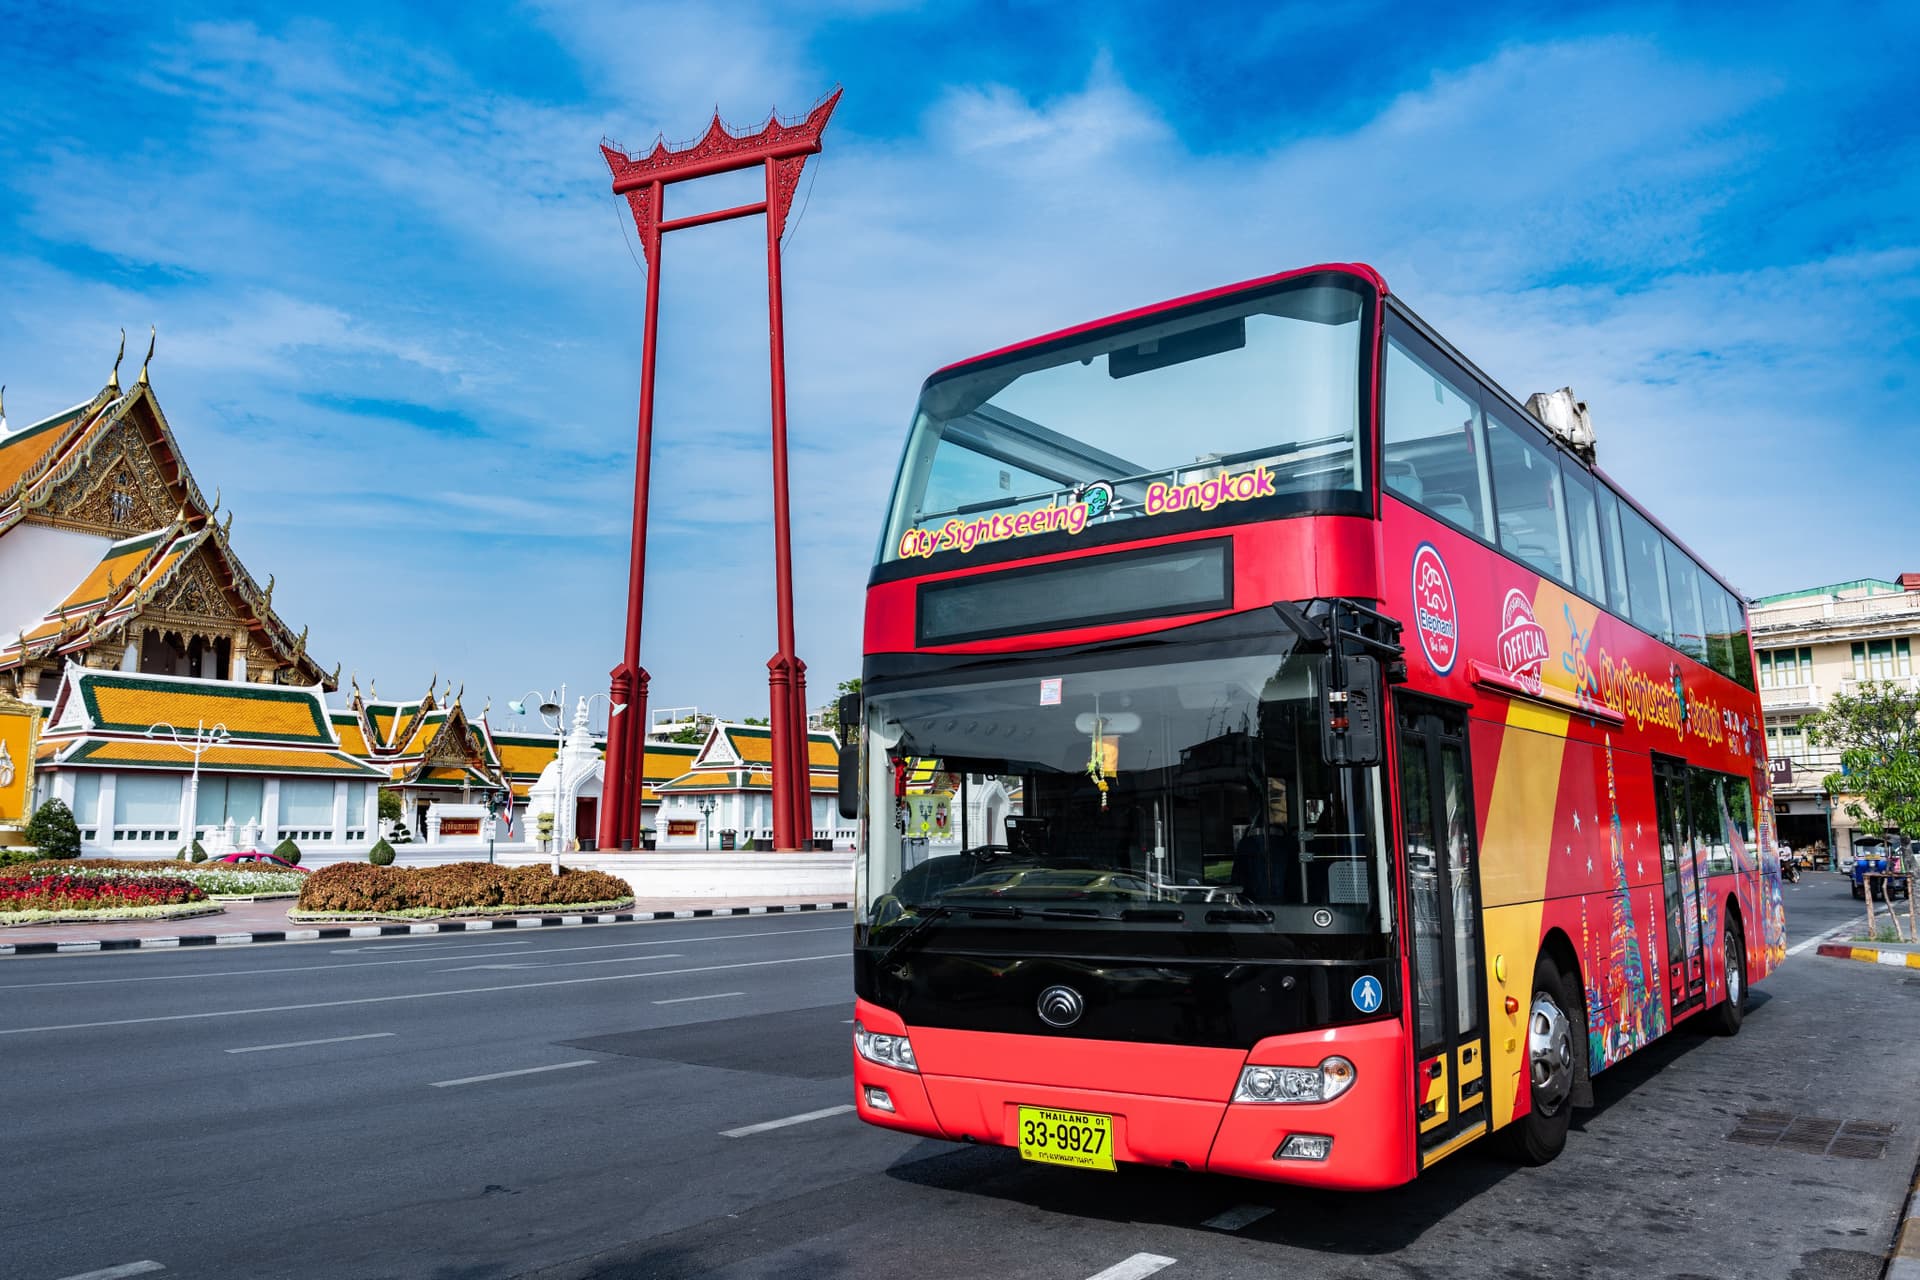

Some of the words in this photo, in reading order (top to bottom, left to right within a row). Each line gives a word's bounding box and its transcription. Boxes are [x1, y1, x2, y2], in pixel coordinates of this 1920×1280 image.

[1145, 465, 1276, 516] Bangkok
[1420, 607, 1454, 639] Elephant
[1503, 630, 1548, 672] OFFICIAL
[1689, 688, 1722, 748] Bangkok
[1024, 1120, 1106, 1154] 33-9927
[1040, 1111, 1089, 1123] THAILAND
[1095, 1118, 1105, 1126] 01
